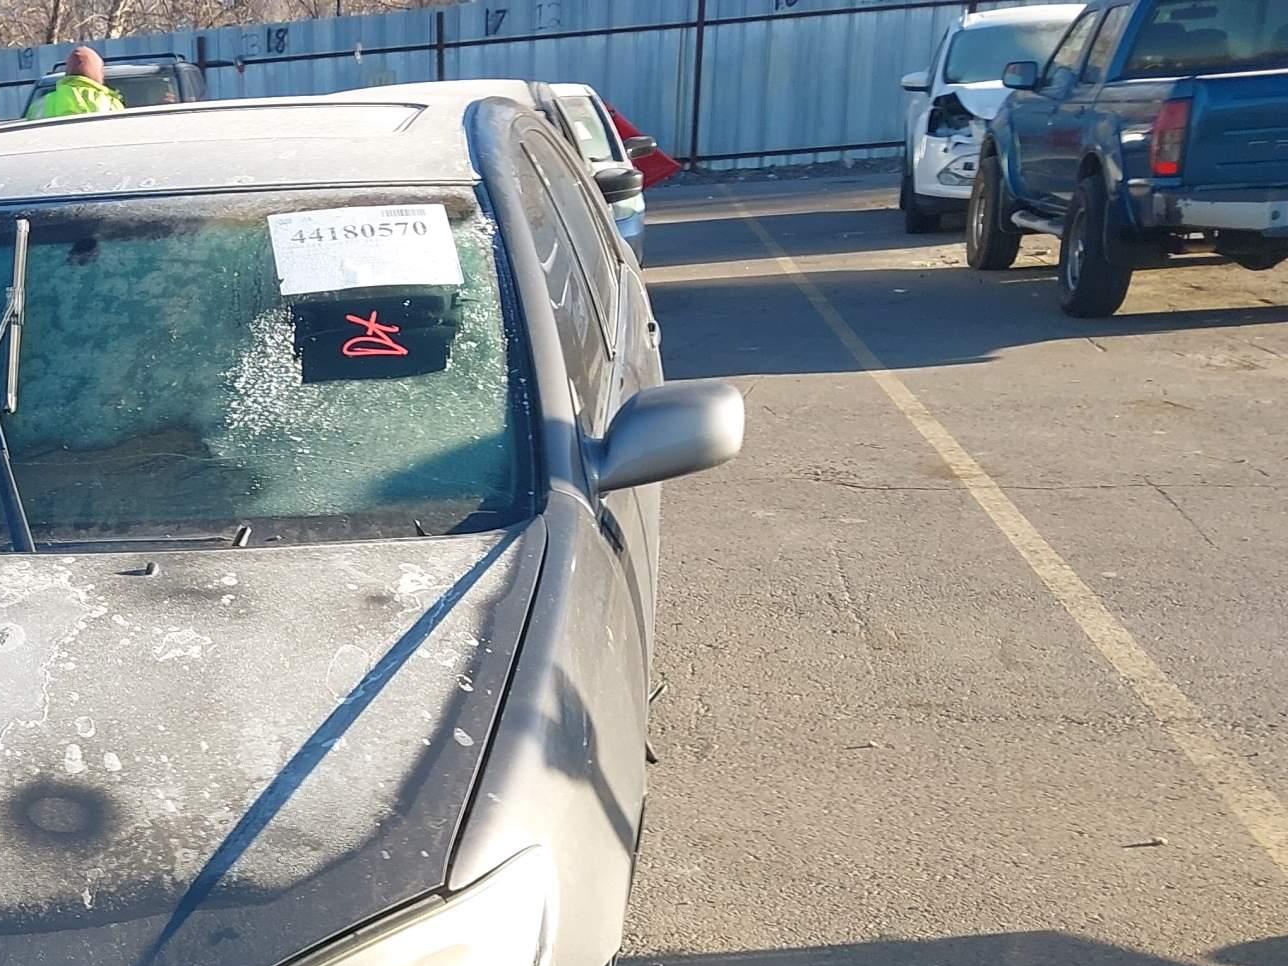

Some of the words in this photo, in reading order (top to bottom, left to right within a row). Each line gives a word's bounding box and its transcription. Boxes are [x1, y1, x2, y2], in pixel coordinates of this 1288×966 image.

[484, 8, 508, 36] 17
[266, 28, 288, 54] 18
[290, 220, 428, 244] 44180570
